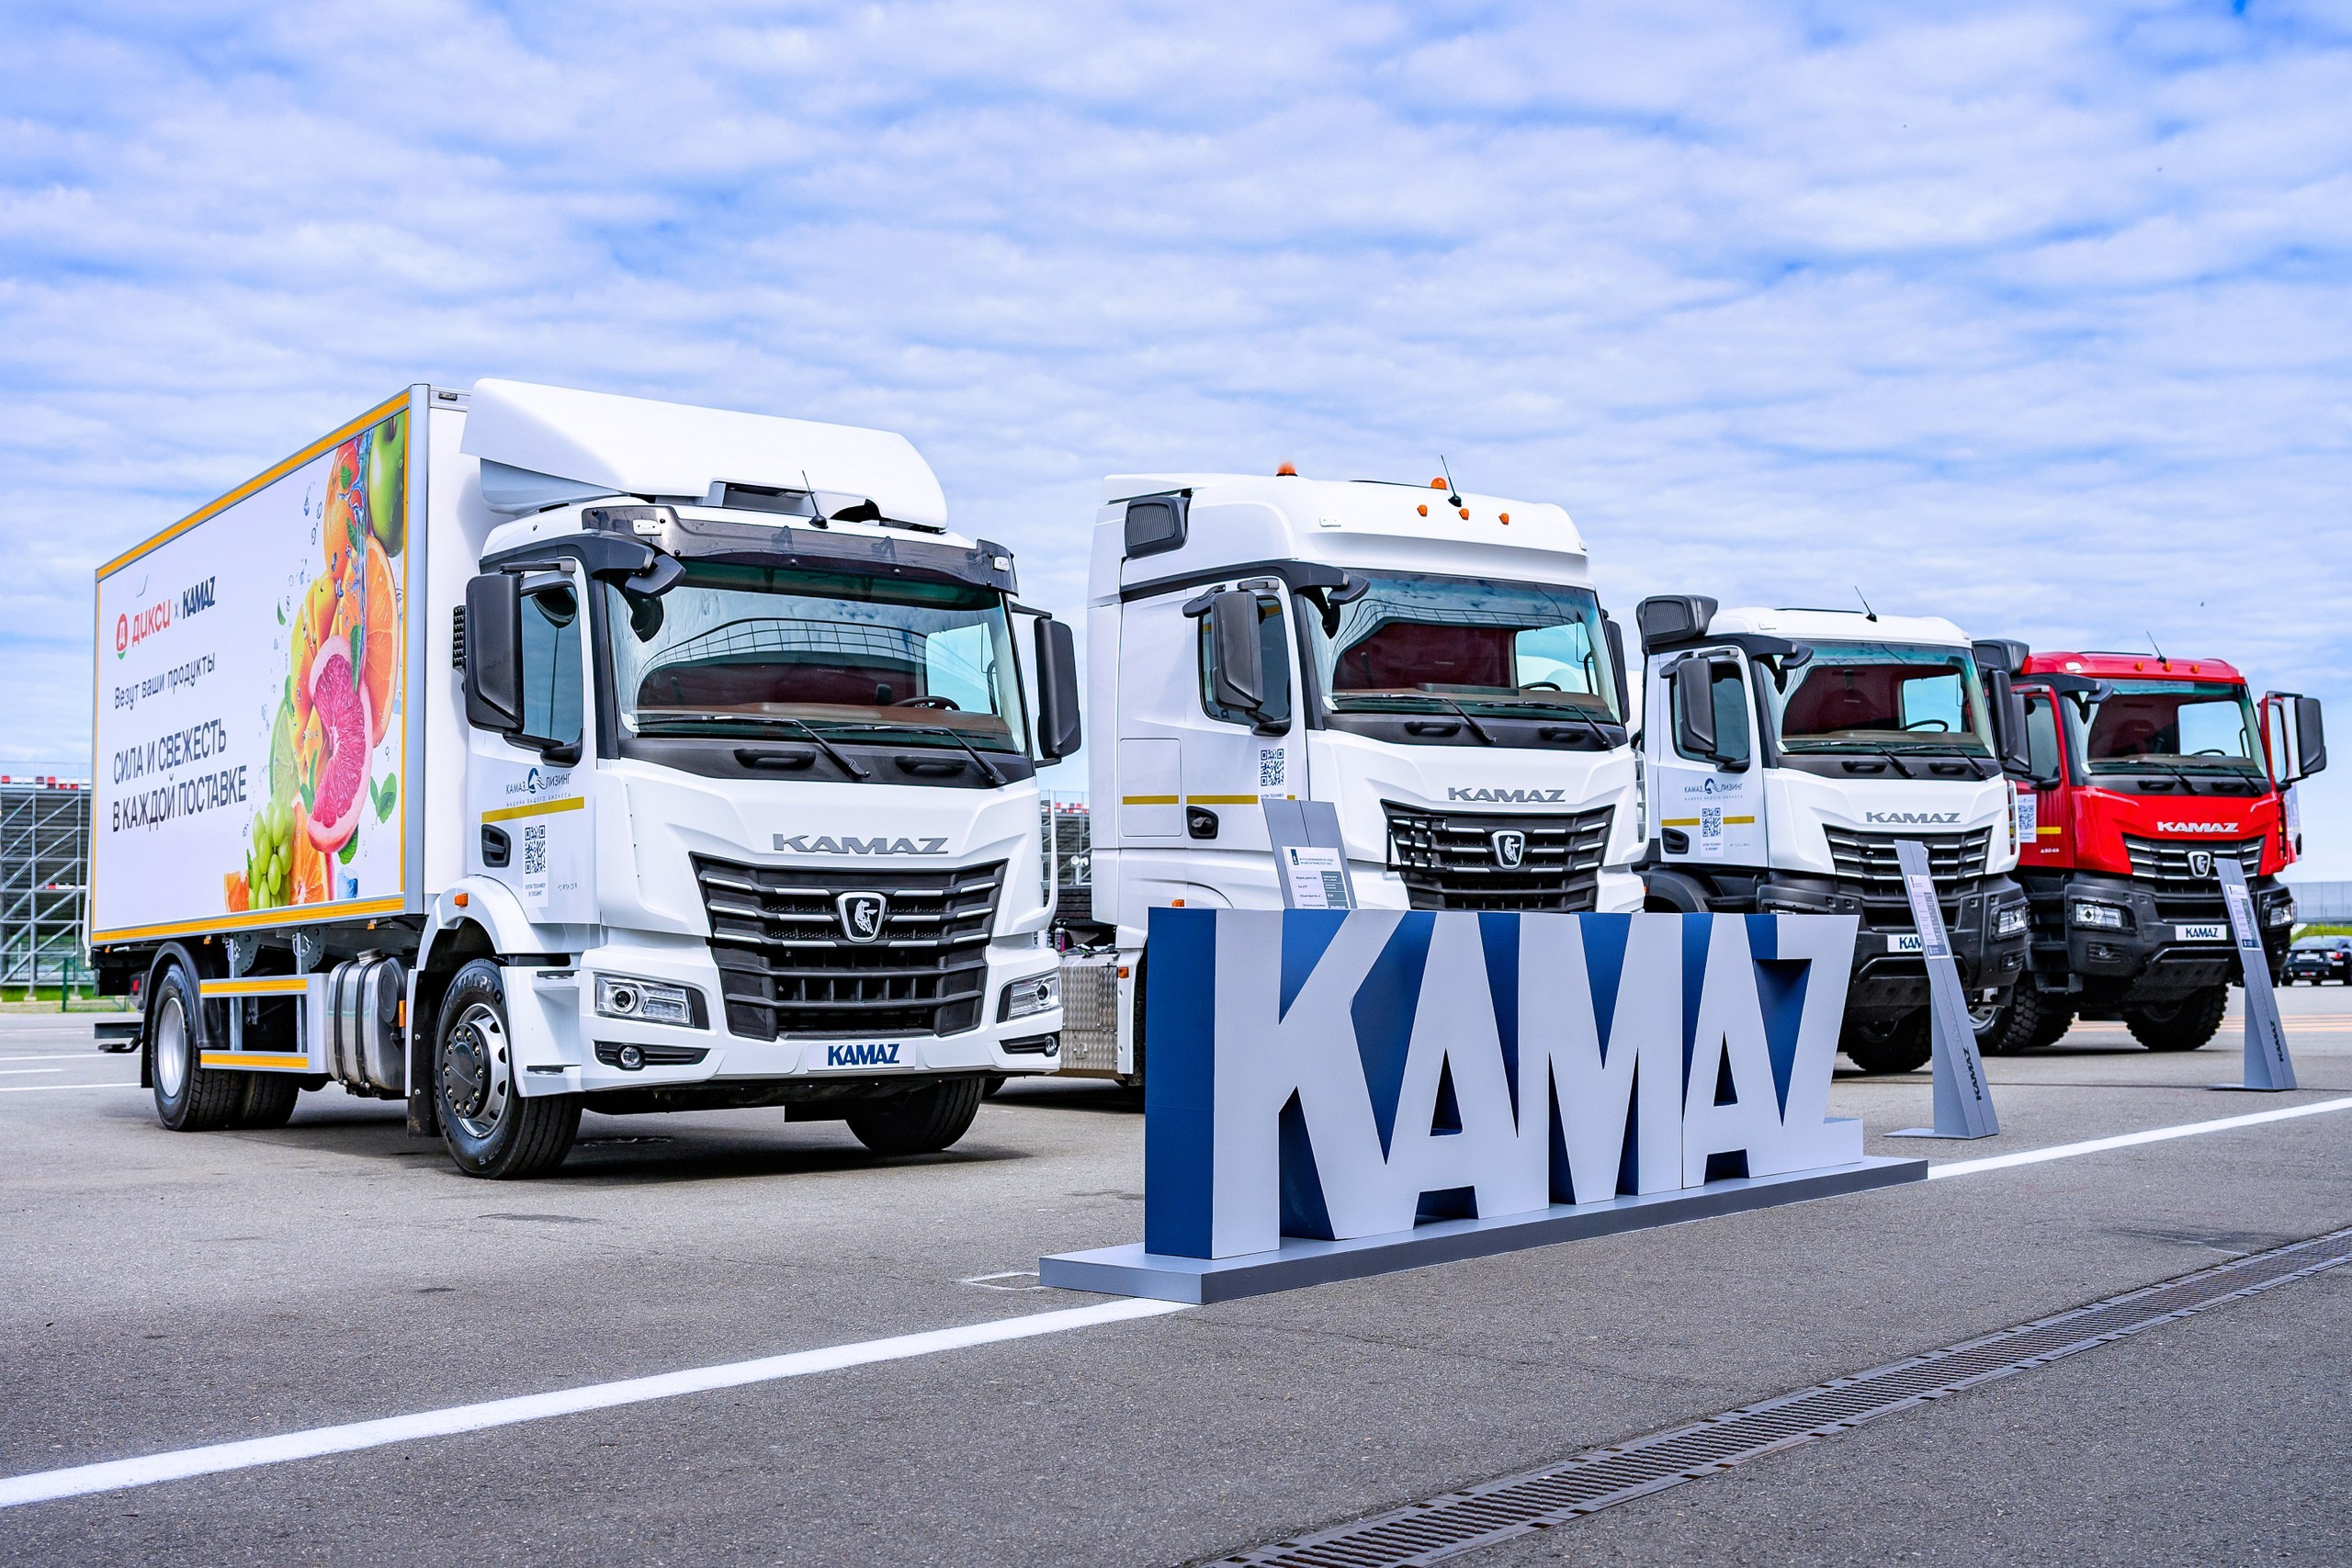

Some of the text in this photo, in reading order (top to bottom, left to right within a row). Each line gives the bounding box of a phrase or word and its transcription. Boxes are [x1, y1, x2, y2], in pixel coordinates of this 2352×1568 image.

[182, 575, 216, 620] KAMAZ
[115, 652, 216, 711] Везут ваши продукты
[113, 717, 227, 784] СИЛА И СВЕЖЕСТЬ
[112, 764, 247, 832] В КАЖДОЙ ПОСТАВКЕ
[1448, 787, 1566, 803] KAMAZ
[1865, 811, 1962, 824] KAMAZ
[2156, 821, 2240, 833] KAMAZ
[773, 833, 949, 854] KAMAZ
[1899, 936, 1922, 950] KAM
[2186, 927, 2219, 939] KAMAZ
[828, 1043, 900, 1066] KAMAZ
[1212, 908, 1863, 1259] KAMAZ
[1962, 1046, 1983, 1101] KAMAZ
